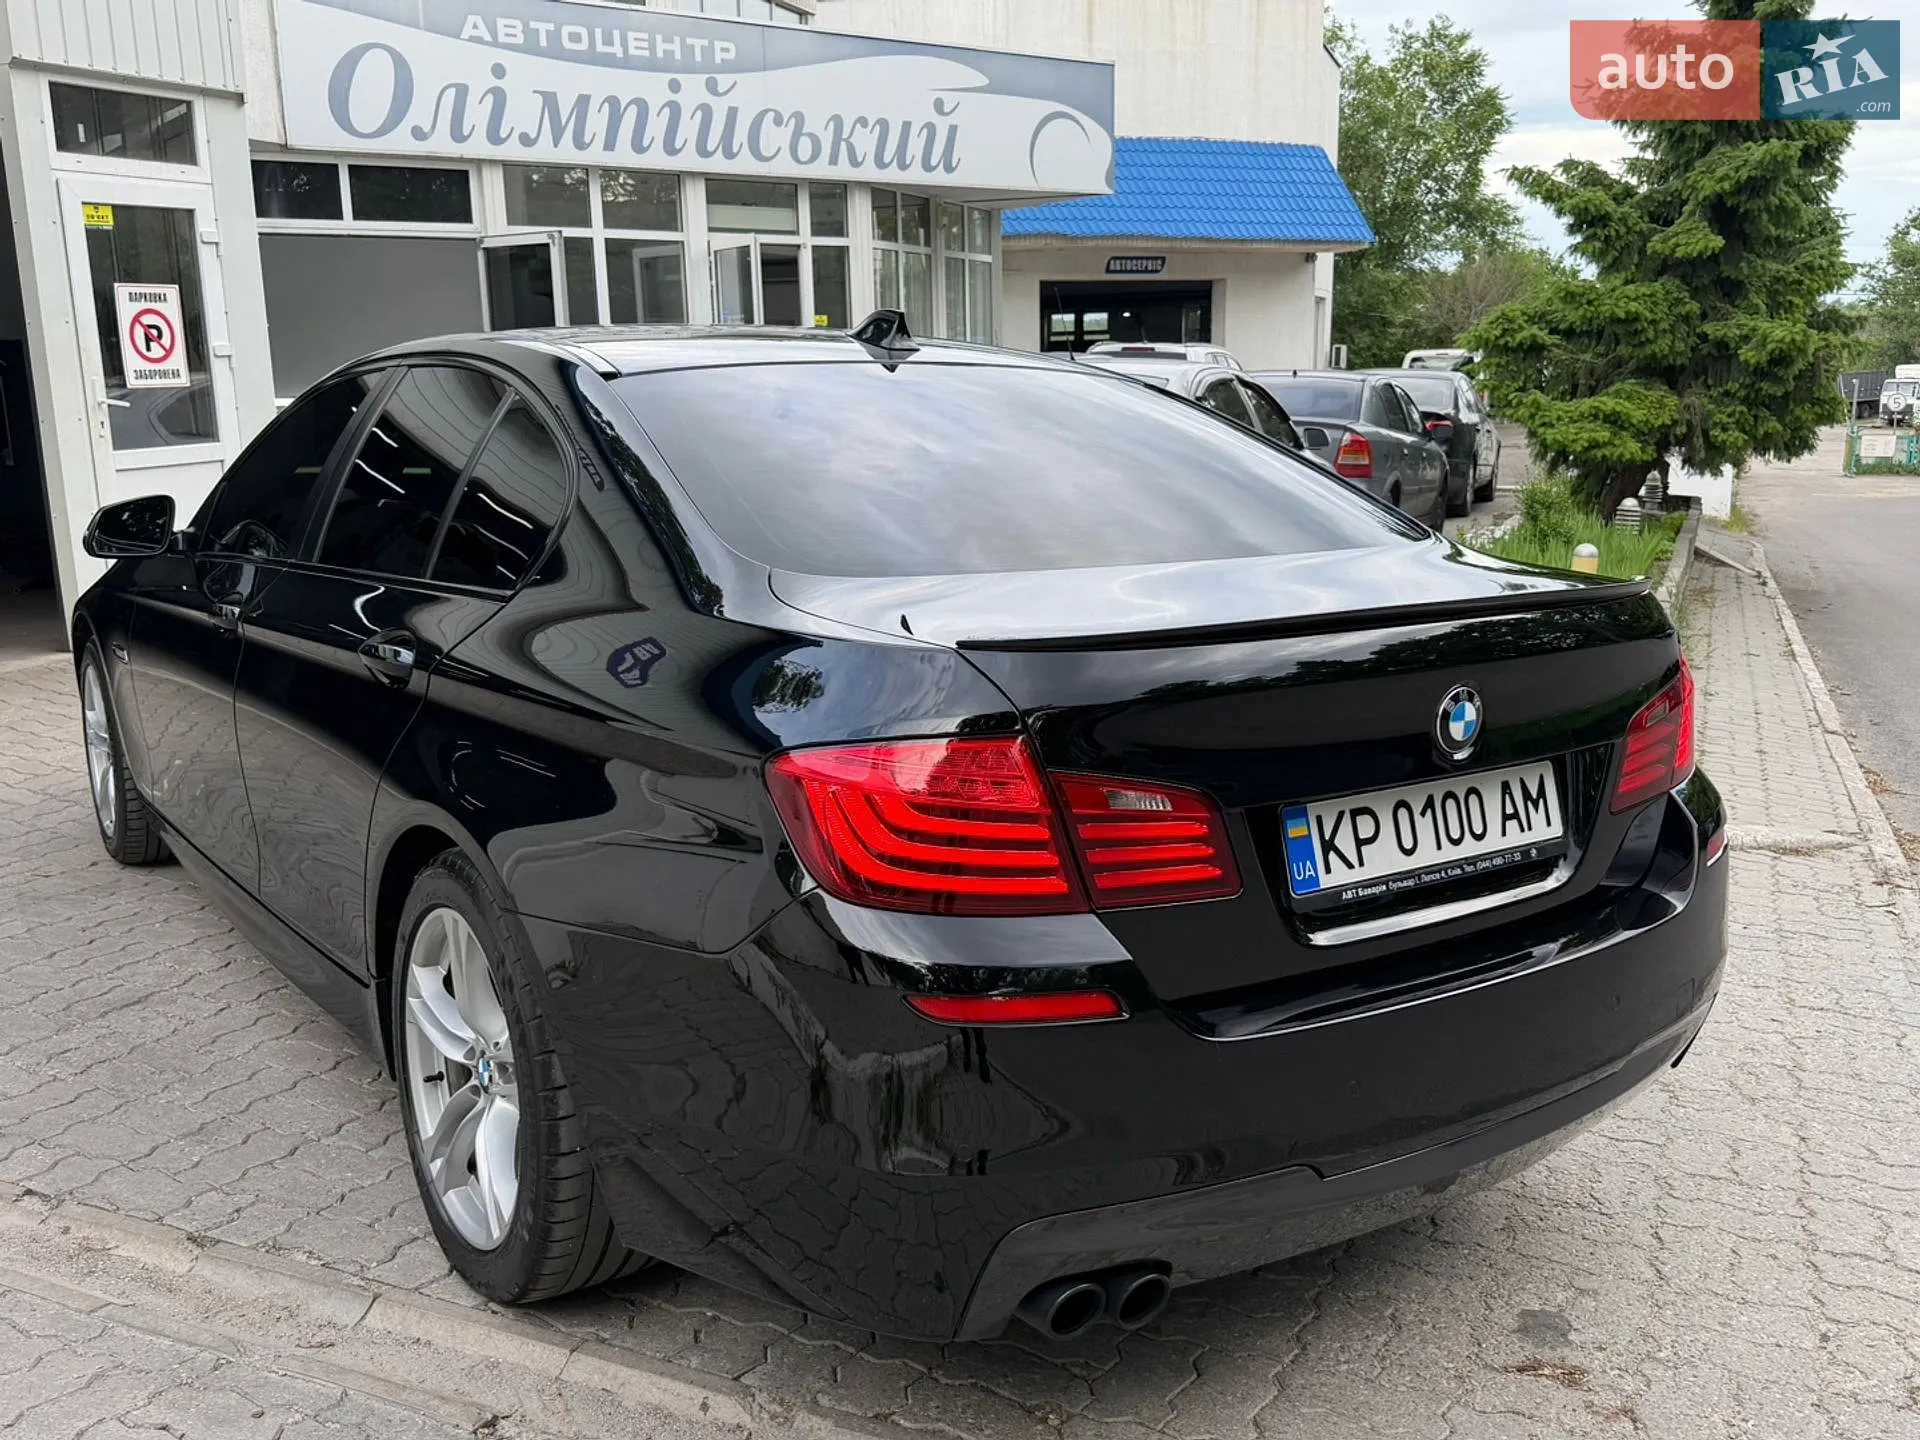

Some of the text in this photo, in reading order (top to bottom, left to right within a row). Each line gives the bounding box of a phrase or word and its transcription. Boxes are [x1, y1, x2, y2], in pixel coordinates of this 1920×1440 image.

[460, 14, 738, 64] АВТОЦЕНТР
[327, 42, 961, 175] Олімпійський
[1109, 259, 1161, 270] АВТОСЕРВІС
[128, 292, 167, 303] ПАРКОВКА
[133, 368, 181, 380] ЗАБОРОНЕНА
[1893, 397, 1901, 408] 5
[1315, 773, 1552, 875] KP 0100 AM
[1292, 860, 1316, 881] UA
